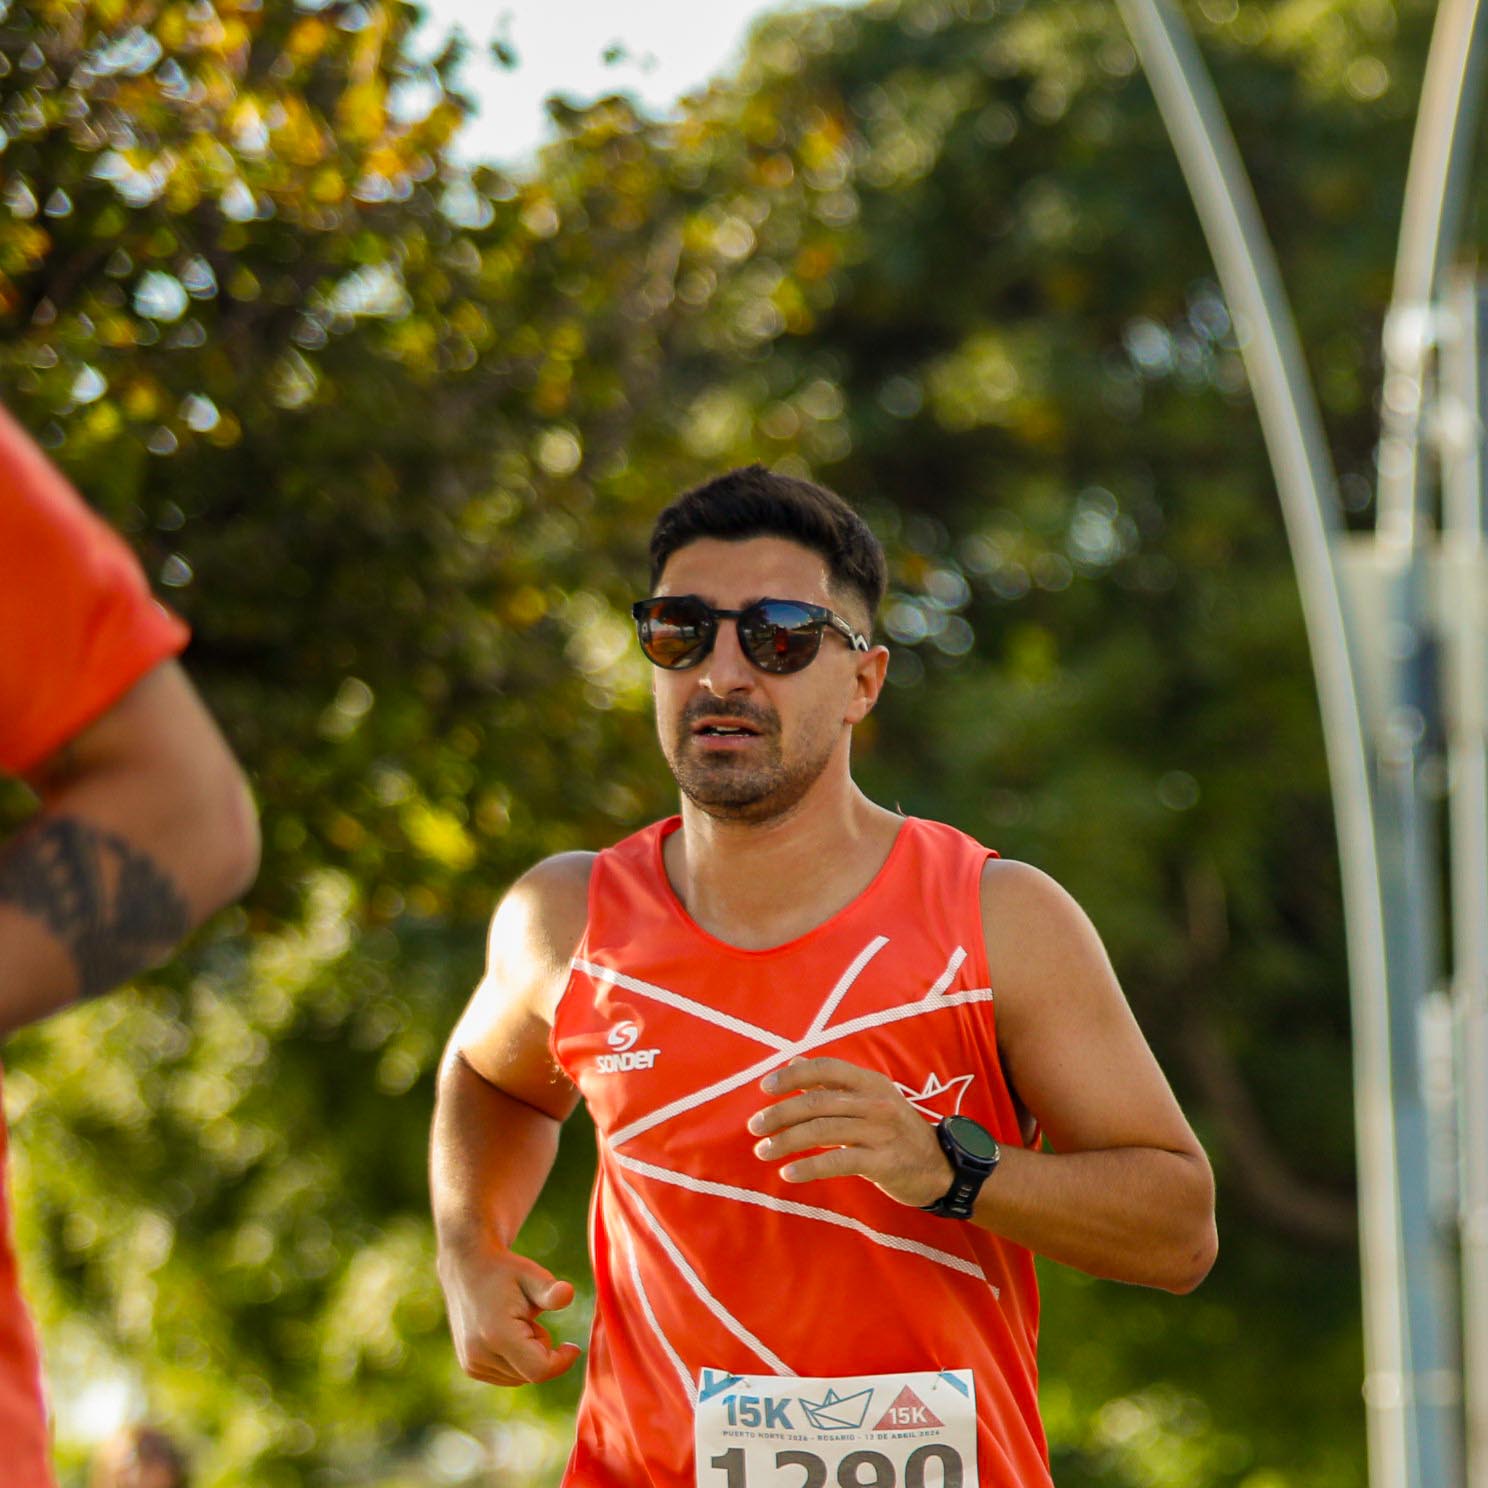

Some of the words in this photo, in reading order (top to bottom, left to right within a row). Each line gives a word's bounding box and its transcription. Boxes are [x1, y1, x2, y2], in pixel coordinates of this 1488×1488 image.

[722, 1394, 795, 1430] 15K
[888, 1406, 928, 1425] 15K
[722, 1430, 755, 1438] PUERTO
[758, 1432, 785, 1440] NORTE
[817, 1433, 856, 1441] ROSARIO
[891, 1431, 917, 1440] ABRIL
